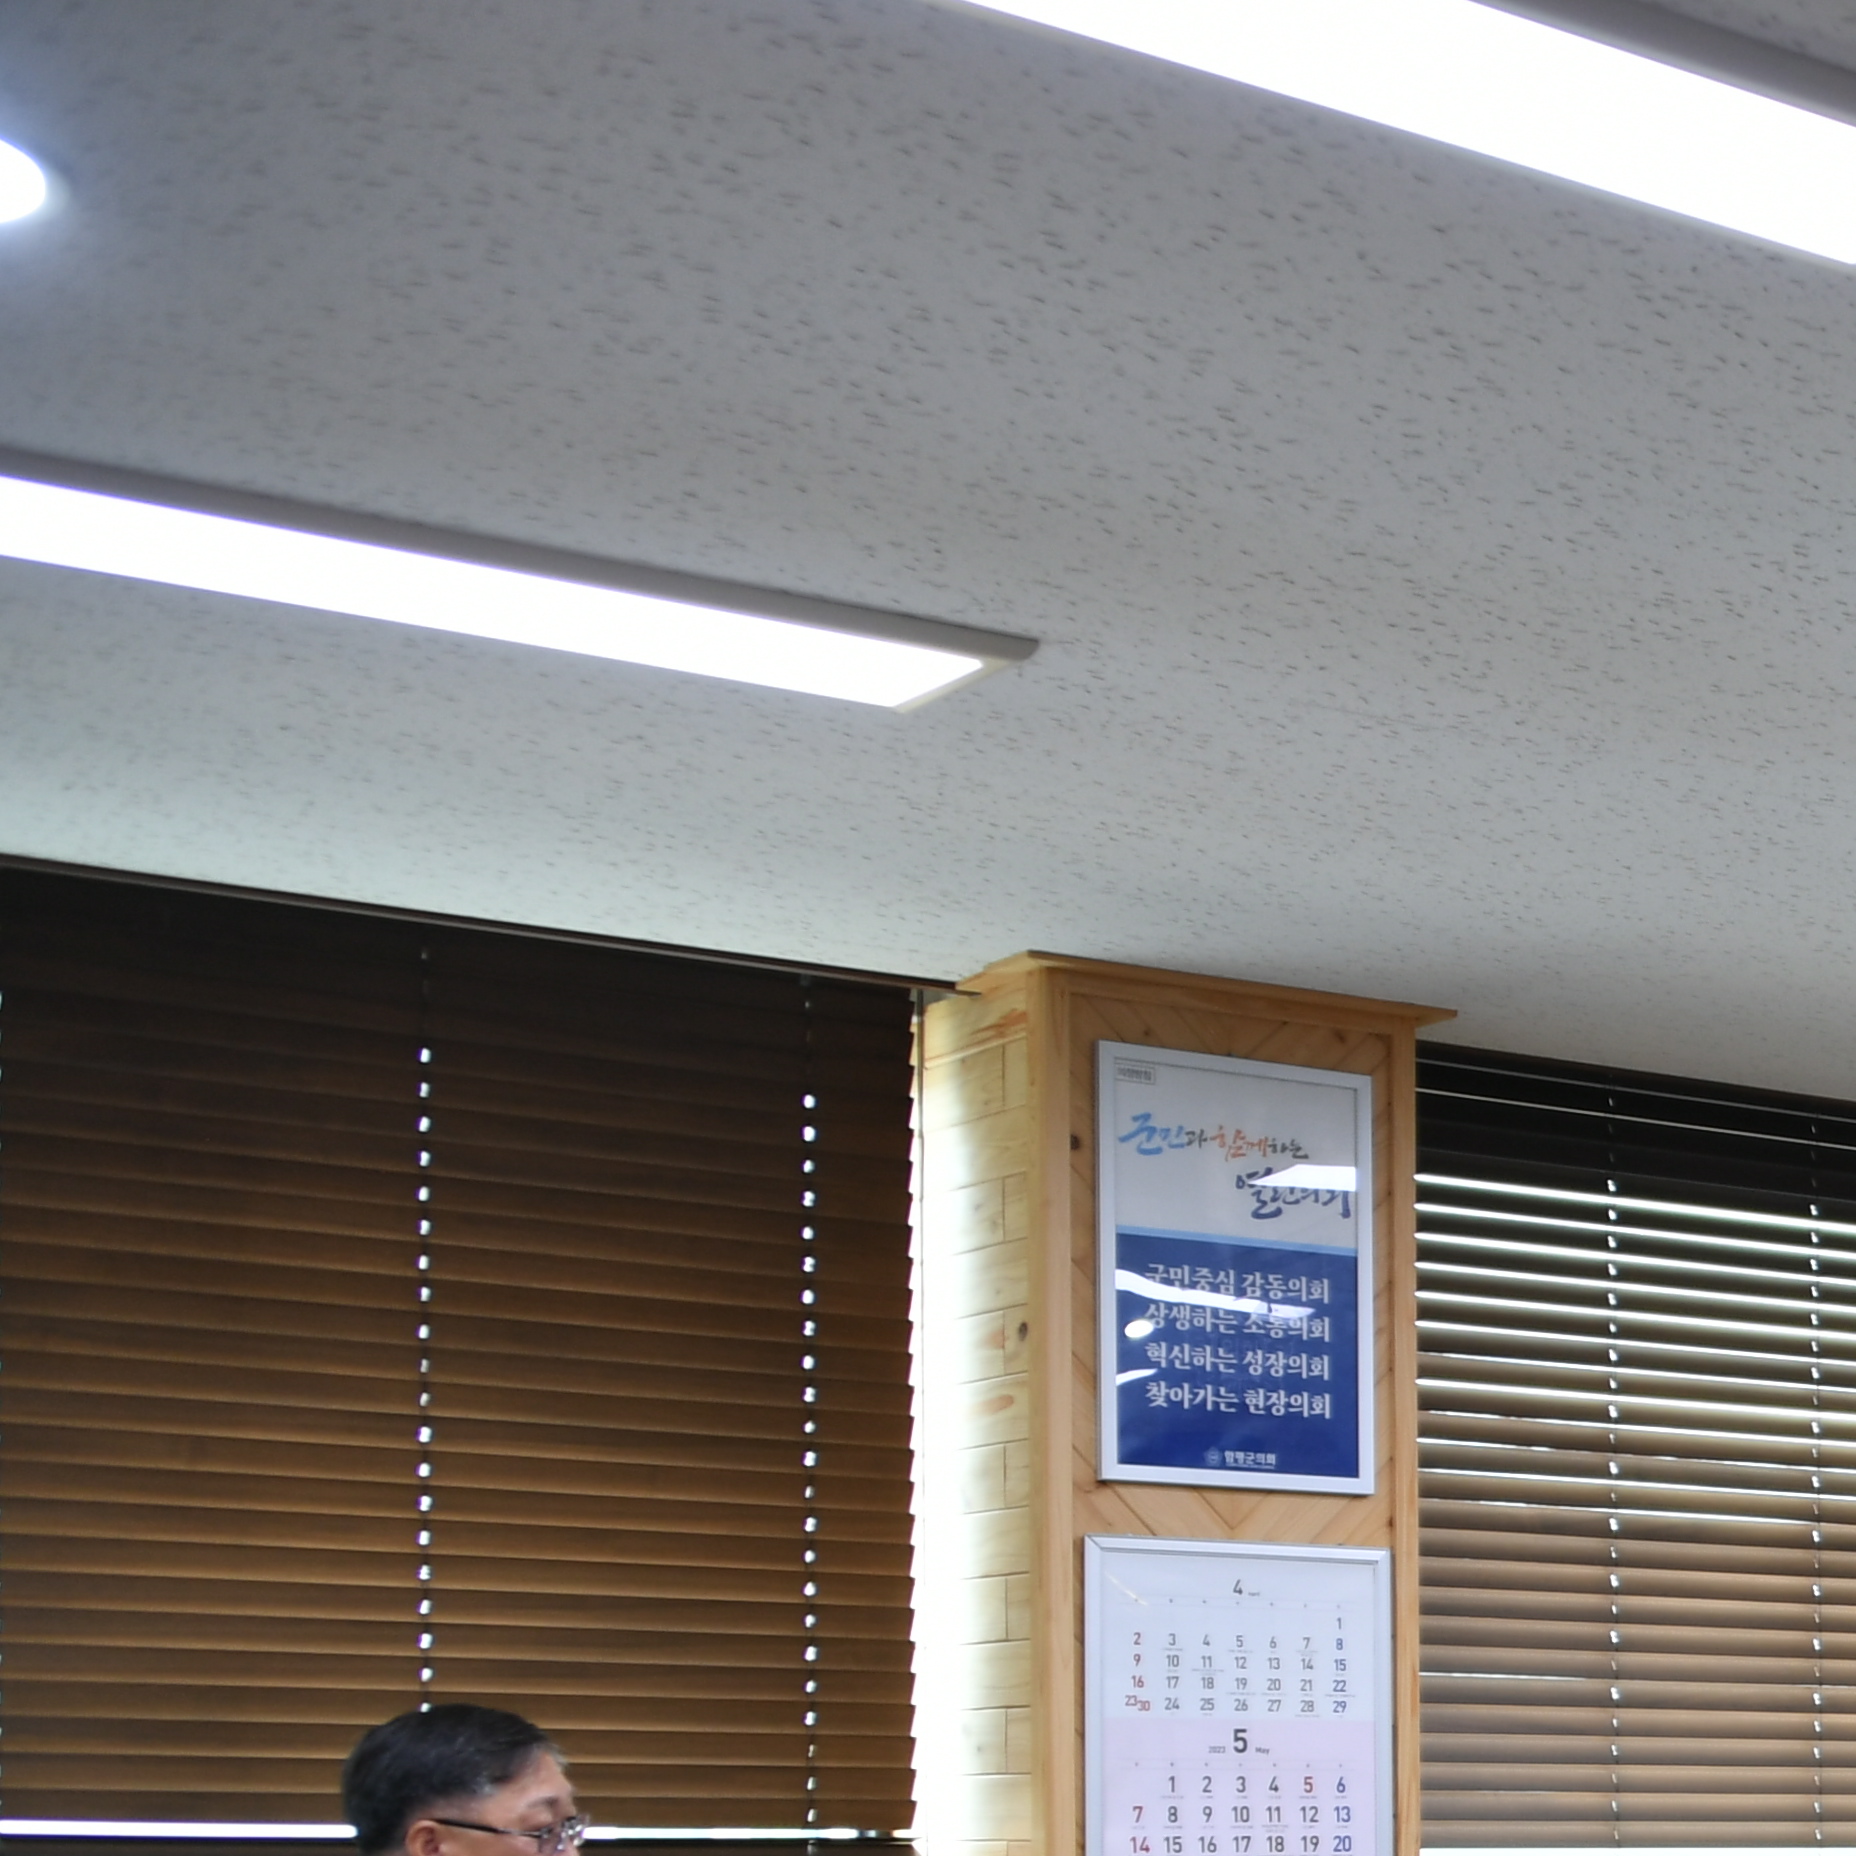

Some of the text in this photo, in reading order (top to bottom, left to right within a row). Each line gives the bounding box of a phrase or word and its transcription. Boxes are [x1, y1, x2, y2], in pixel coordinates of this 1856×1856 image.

[1117, 1112, 1309, 1162] 군민과 함께하는
[1241, 1271, 1330, 1304] 감동의회
[1144, 1302, 1238, 1334] 상생하는
[1144, 1341, 1330, 1381] 혁신하는 성장의회
[1145, 1381, 1331, 1419] 찾아가는 현장의회
[1233, 1579, 1243, 1595] 4
[1337, 1617, 1342, 1630] 1
[1133, 1632, 1343, 1651] 2 3 4 5 6 7 8
[1133, 1653, 1346, 1671] 9 10 11 12 13 14 15
[1131, 1675, 1346, 1692] 16 17 18 19 20 21 22
[1125, 1695, 1347, 1713] 23 30 24 25 26 27 28 29
[1234, 1728, 1248, 1753] 5
[1255, 1745, 1270, 1756] May
[1168, 1775, 1346, 1793] 1 2 3 4 5 6
[1133, 1806, 1351, 1823] 7 8 9 10 11 12 13
[1130, 1835, 1352, 1853] 14 15 16 17 18 19 20
